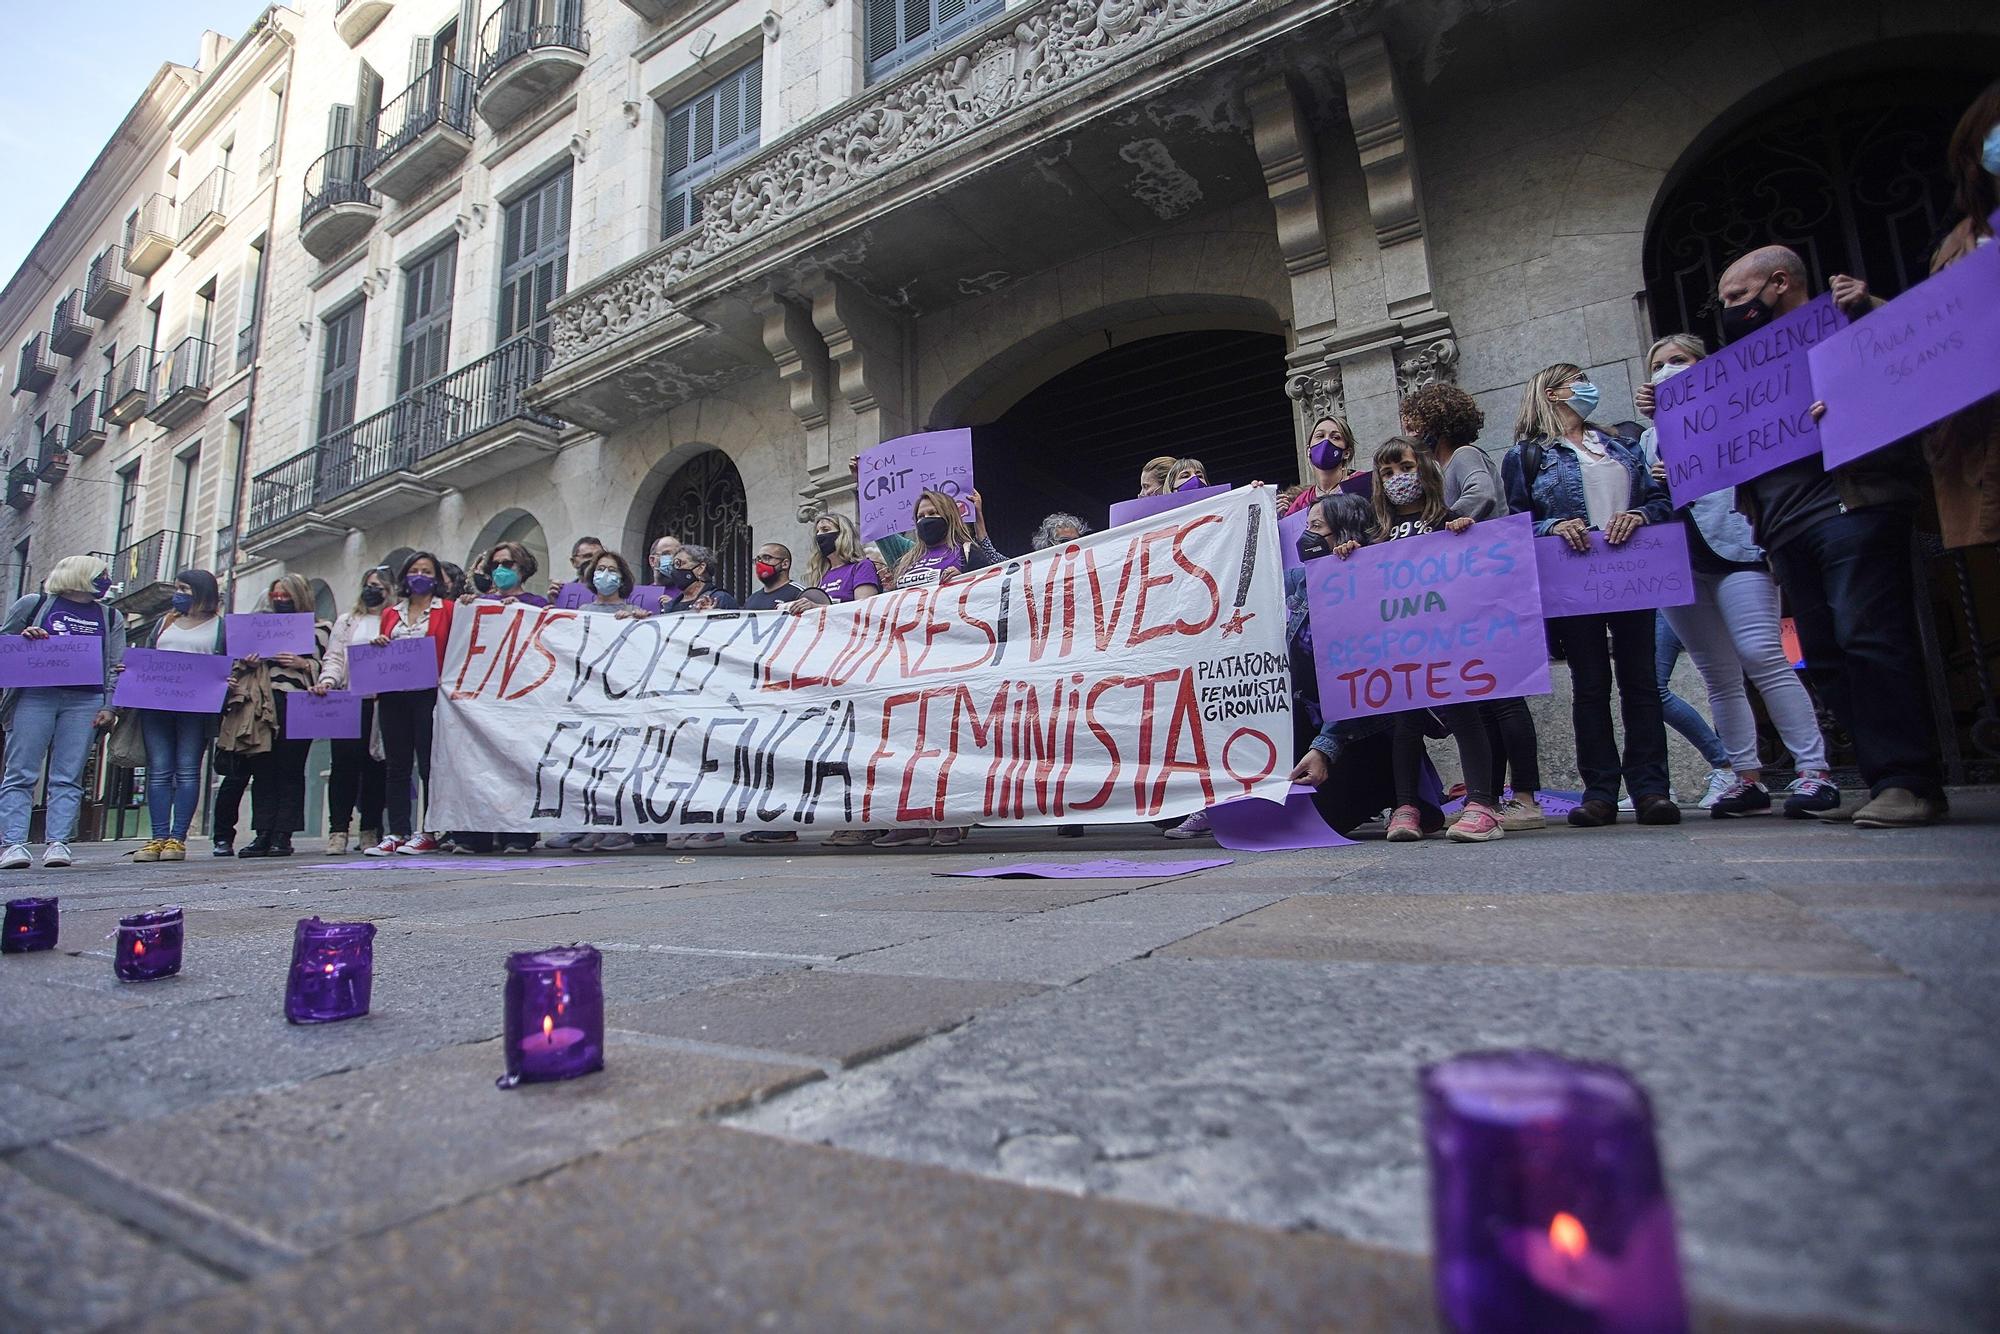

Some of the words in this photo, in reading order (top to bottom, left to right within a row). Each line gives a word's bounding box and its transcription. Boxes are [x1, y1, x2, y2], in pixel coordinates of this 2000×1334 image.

[1884, 355, 1913, 385] 36
[1917, 331, 1964, 368] ANYS
[1660, 375, 1696, 412] QUE
[1704, 359, 1728, 392] LA
[1683, 405, 1717, 440] NO
[864, 454, 896, 474] SOM
[911, 446, 936, 457] EL
[1669, 454, 1703, 488] UNA
[1717, 407, 1819, 468] HERÈNC
[920, 473, 936, 483] DE
[946, 466, 967, 476] LES
[865, 507, 887, 523] QUE
[1376, 542, 1516, 591] TOQUES
[1588, 559, 1647, 577] ALARDO
[1584, 577, 1616, 603] 48
[1621, 571, 1682, 599] ANYS
[1380, 591, 1447, 622] UNA
[450, 605, 577, 701] ENS
[566, 611, 790, 702] VOLEM
[1198, 651, 1290, 680] PLATAFORMA
[1201, 676, 1287, 702] FEMINISTA
[1336, 658, 1498, 708] TOTES
[1204, 694, 1290, 721] GIRONINA
[531, 691, 855, 827] EMERGÈNCIA
